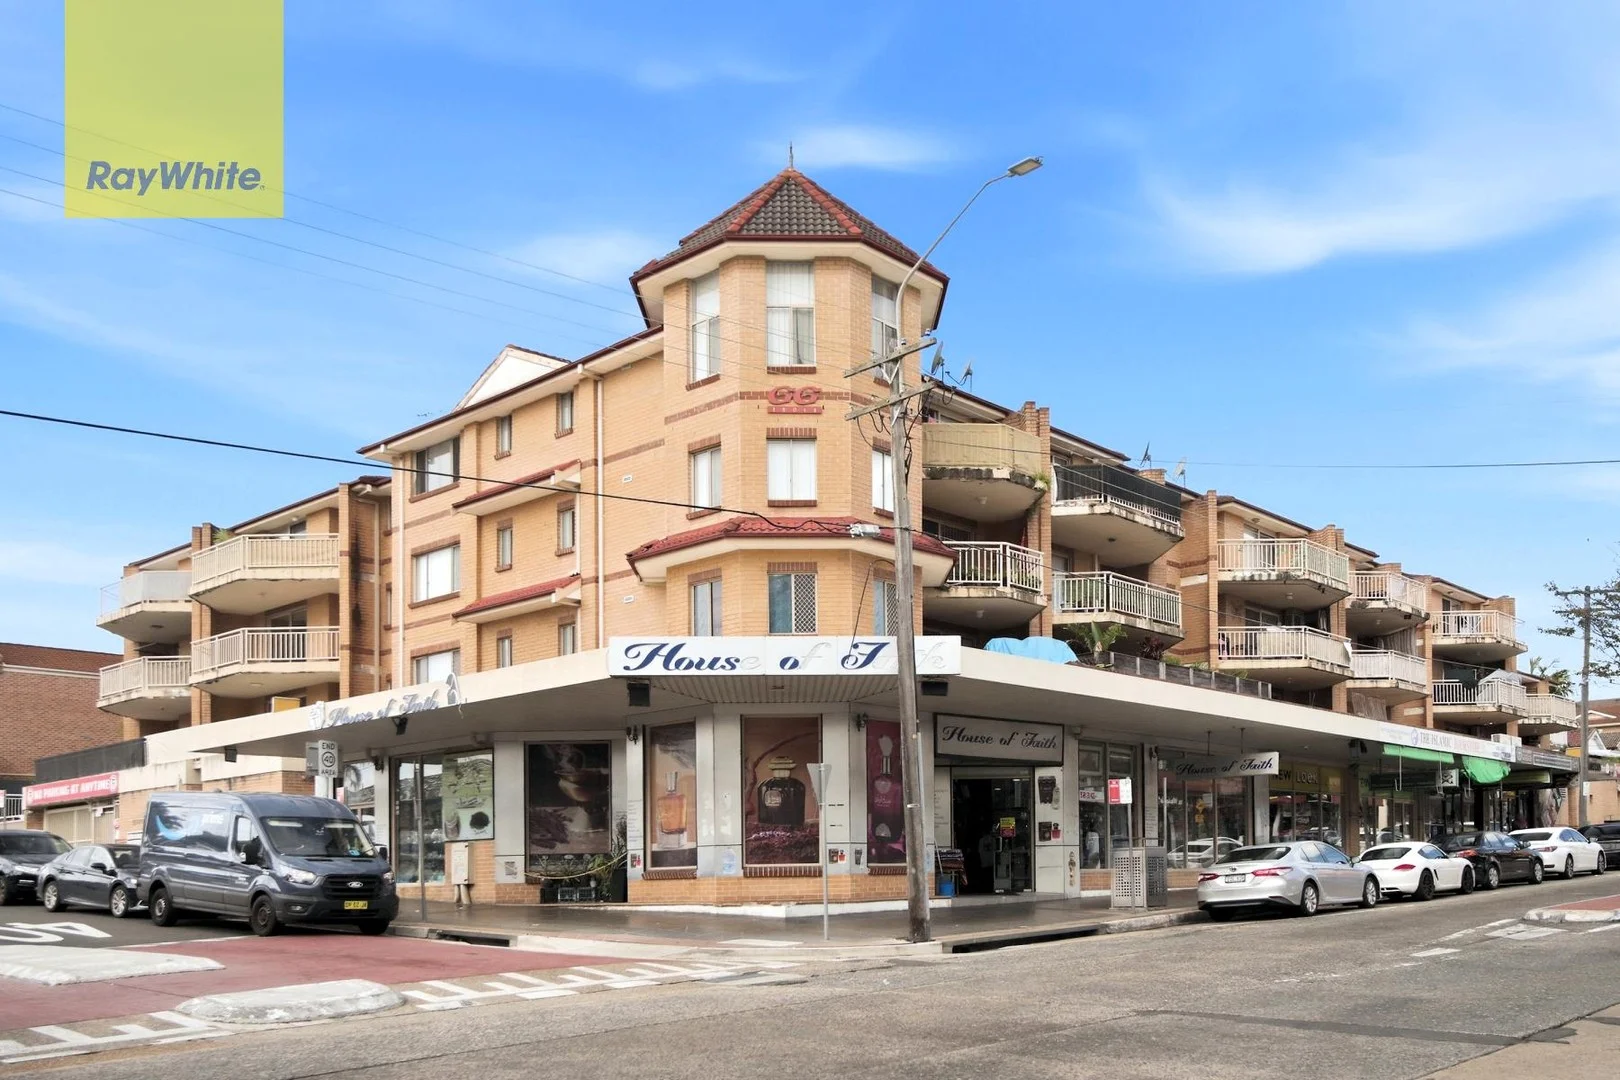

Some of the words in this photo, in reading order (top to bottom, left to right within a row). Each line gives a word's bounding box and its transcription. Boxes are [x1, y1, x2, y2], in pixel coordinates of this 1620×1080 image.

[942, 726, 994, 745] House
[1000, 731, 1019, 746] of
[1021, 732, 1057, 749] Faith
[322, 742, 336, 751] END
[323, 755, 335, 765] 40
[1176, 763, 1217, 776] House
[1221, 760, 1238, 772] of
[1240, 757, 1274, 772] Faith
